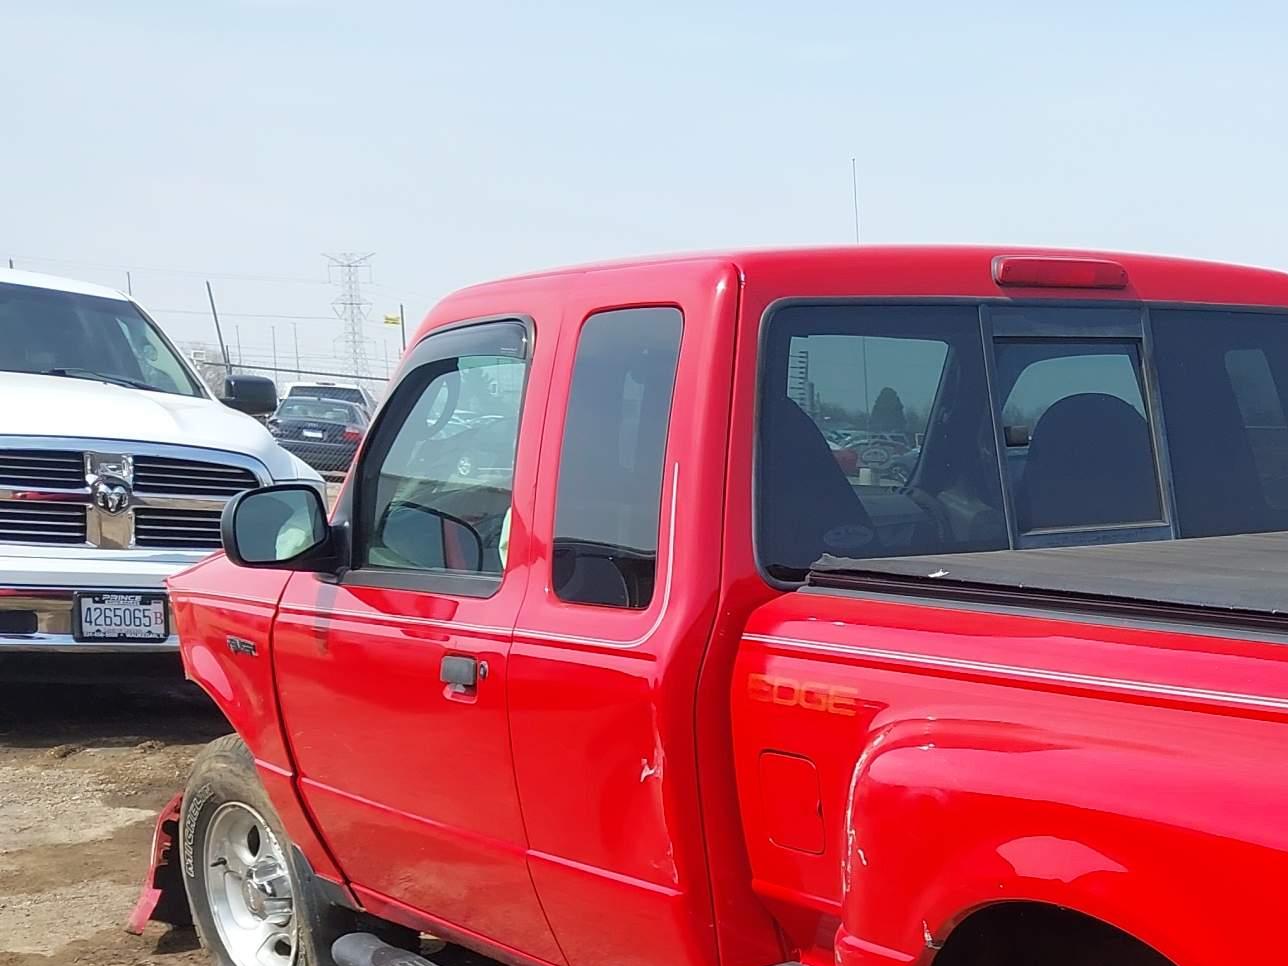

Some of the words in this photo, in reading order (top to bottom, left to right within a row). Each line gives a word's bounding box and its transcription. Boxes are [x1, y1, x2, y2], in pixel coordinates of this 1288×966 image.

[84, 607, 152, 627] 4265065
[154, 611, 164, 625] B
[747, 672, 859, 717] EDGE
